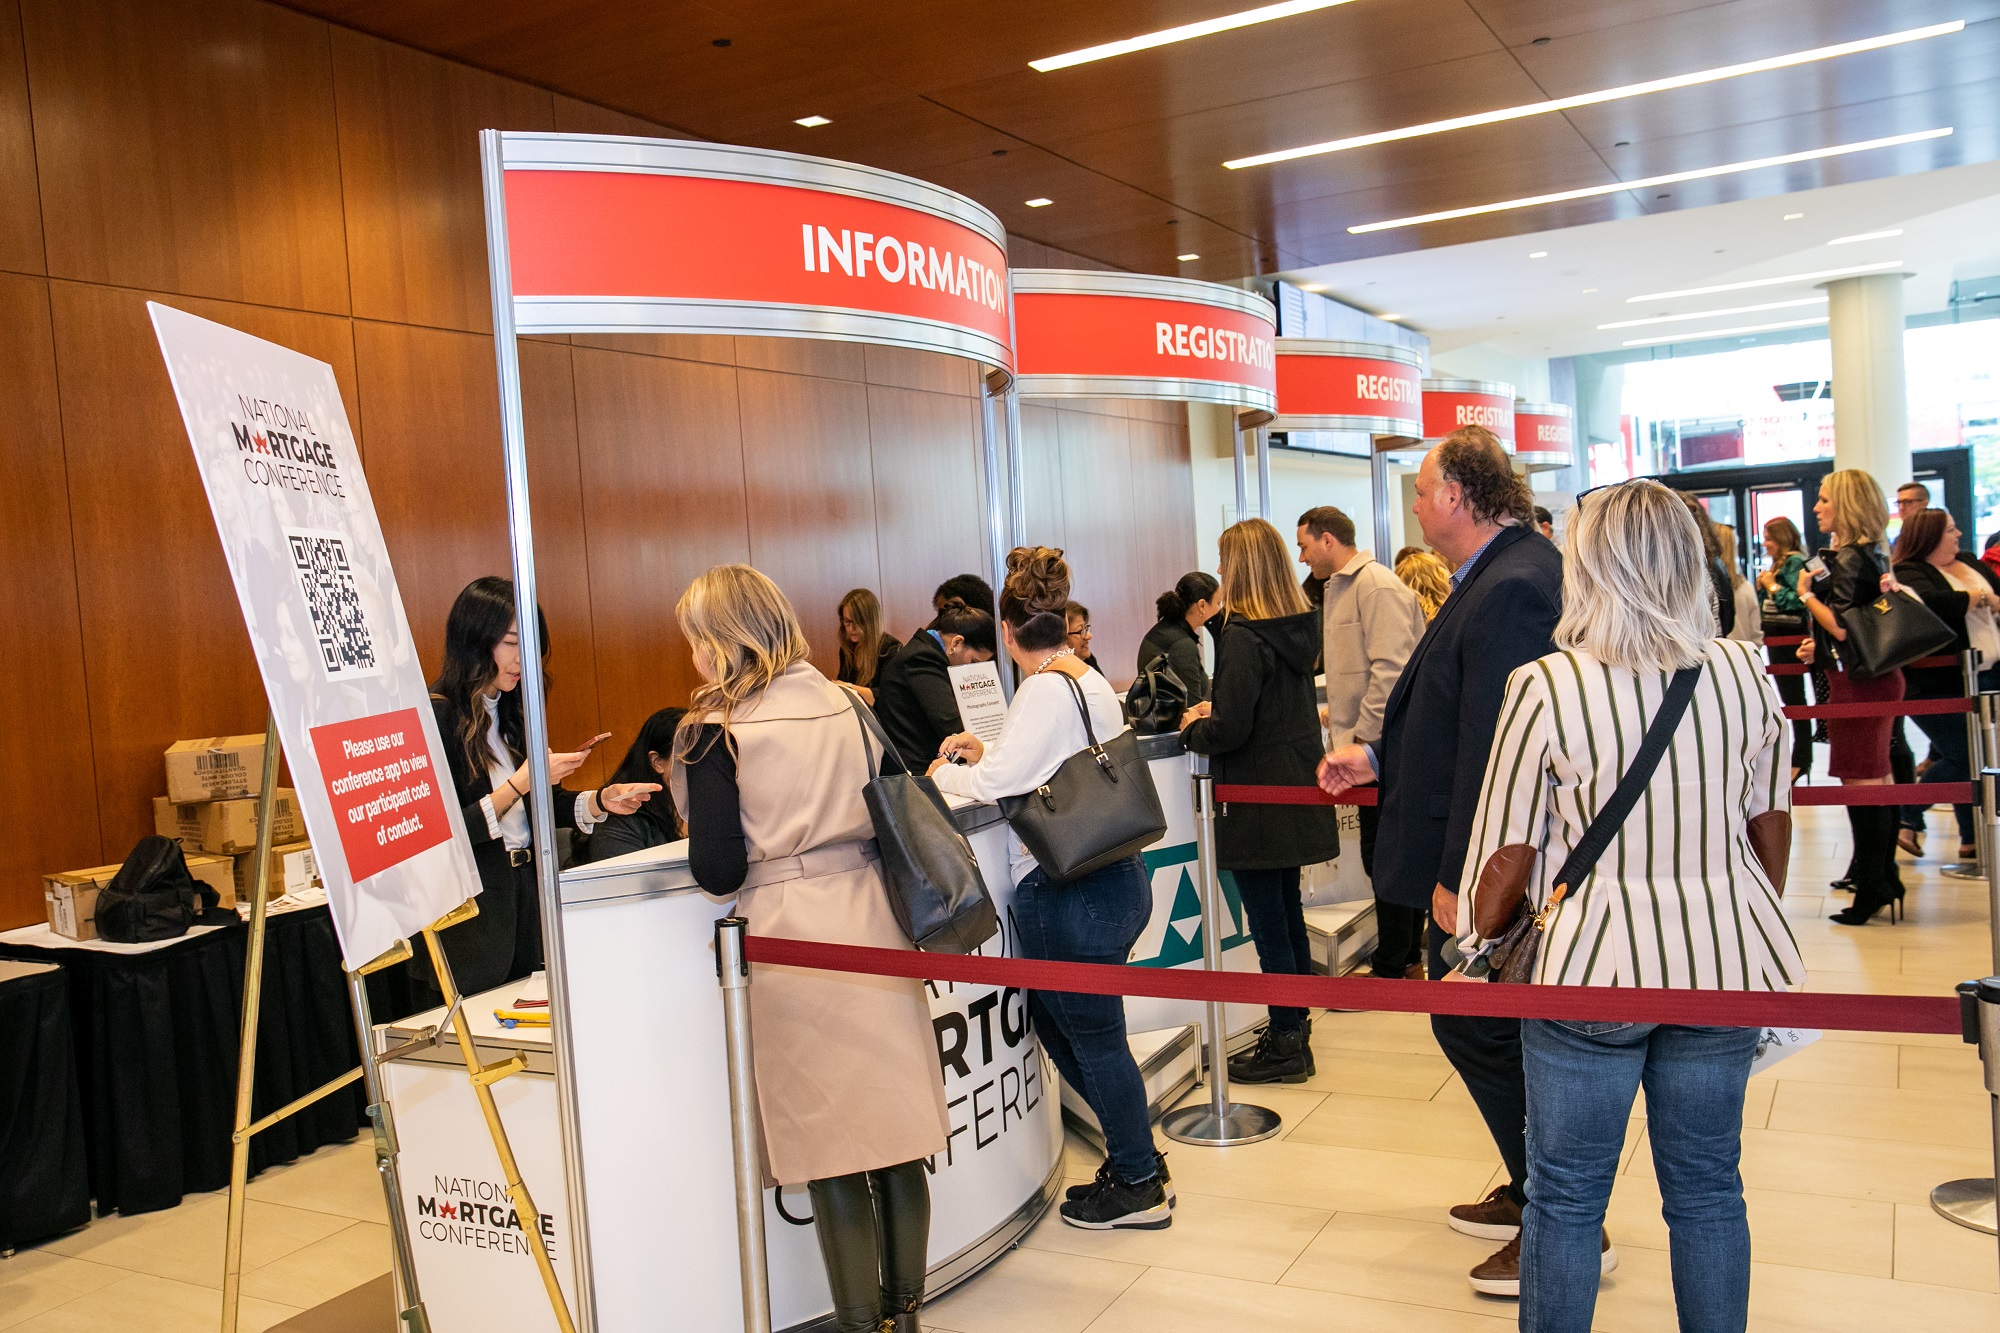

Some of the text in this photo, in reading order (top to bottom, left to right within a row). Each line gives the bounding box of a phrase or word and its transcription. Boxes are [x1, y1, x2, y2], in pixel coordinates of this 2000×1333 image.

[802, 223, 1005, 317] INFORMATION
[1156, 322, 1273, 372] REGISTRATIO
[238, 393, 316, 435] NATIONAL
[231, 421, 337, 469] MRTGAGE
[244, 458, 345, 498] CONFERENCE
[959, 680, 996, 692] MRTGAGE
[962, 674, 989, 682] NATIONAL
[962, 687, 998, 699] CONFERENCE
[967, 701, 987, 709] Photography
[342, 731, 404, 759] Please use our
[332, 752, 428, 796] conference app to view
[348, 780, 431, 824] our participant code
[376, 813, 423, 846] of conduct.
[434, 1174, 514, 1204] NATION
[420, 1220, 557, 1261] CONFERENE
